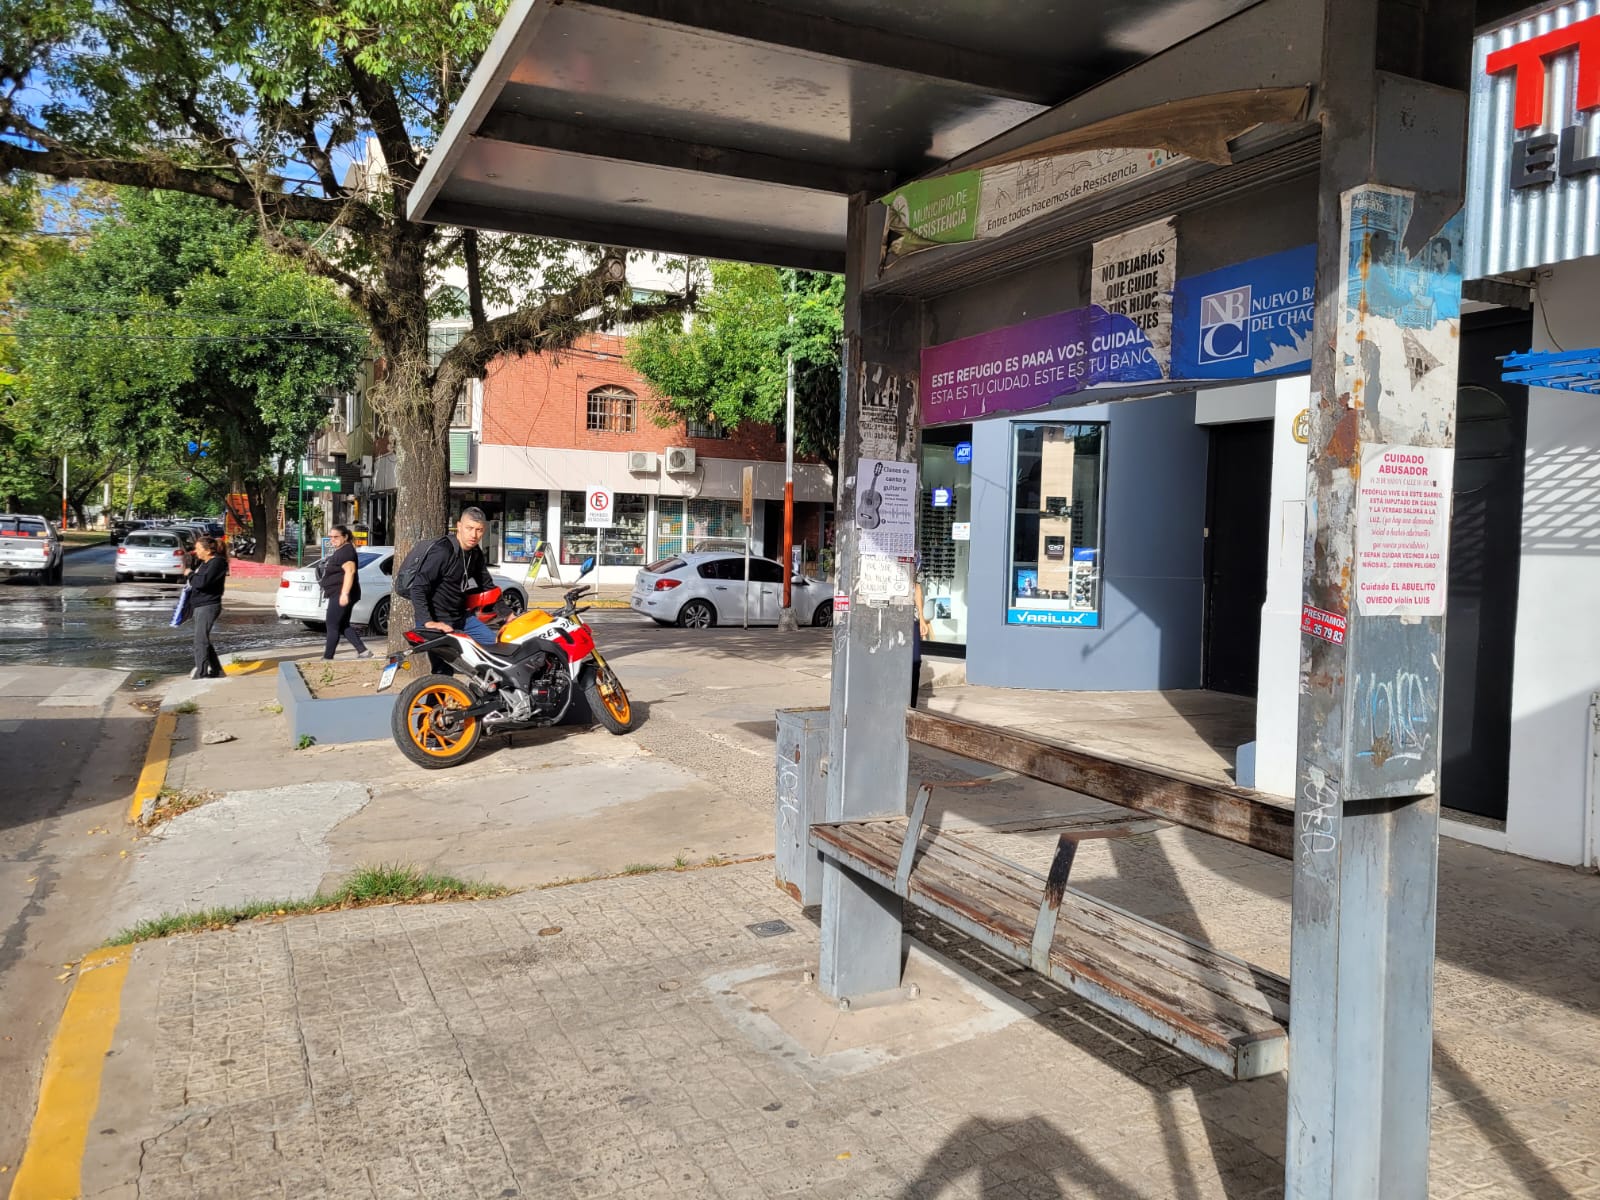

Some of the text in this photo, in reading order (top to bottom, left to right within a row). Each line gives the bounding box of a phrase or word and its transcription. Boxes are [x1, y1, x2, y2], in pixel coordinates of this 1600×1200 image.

[913, 188, 968, 223] MUNICIPIO DE
[987, 162, 1138, 232] Entre todos hacemos de Resistencia
[1102, 264, 1115, 283] NO
[1106, 270, 1158, 302] QUE CUIDE
[1252, 289, 1298, 312] NUEVO
[1251, 315, 1274, 332] DEL
[932, 371, 955, 388] ESTE
[957, 361, 1002, 383] REFUGIO
[1005, 356, 1019, 373] ES
[1021, 350, 1054, 370] PARA
[1058, 340, 1088, 361] VOS.
[931, 389, 954, 406] ESTA
[956, 385, 969, 400] ES
[970, 381, 985, 397] TU
[986, 372, 1032, 395] CIUDAD.
[1034, 365, 1065, 387] ESTE
[1068, 360, 1085, 378] ES
[1088, 355, 1107, 375] TU
[1384, 453, 1424, 465] CUIDADO
[883, 466, 909, 475] Clases de
[885, 476, 901, 484] canto
[1378, 465, 1428, 476] ABUSADOR
[883, 484, 907, 492] guitarra
[1361, 583, 1435, 591] Cuidado EL ABUELITO
[1366, 596, 1393, 605] OVIEDO
[1414, 597, 1430, 605] LUIS
[1303, 607, 1346, 629] PRESTAMOS
[1312, 623, 1323, 635] 35
[1323, 626, 1333, 639] 79
[1332, 630, 1344, 643] 83
